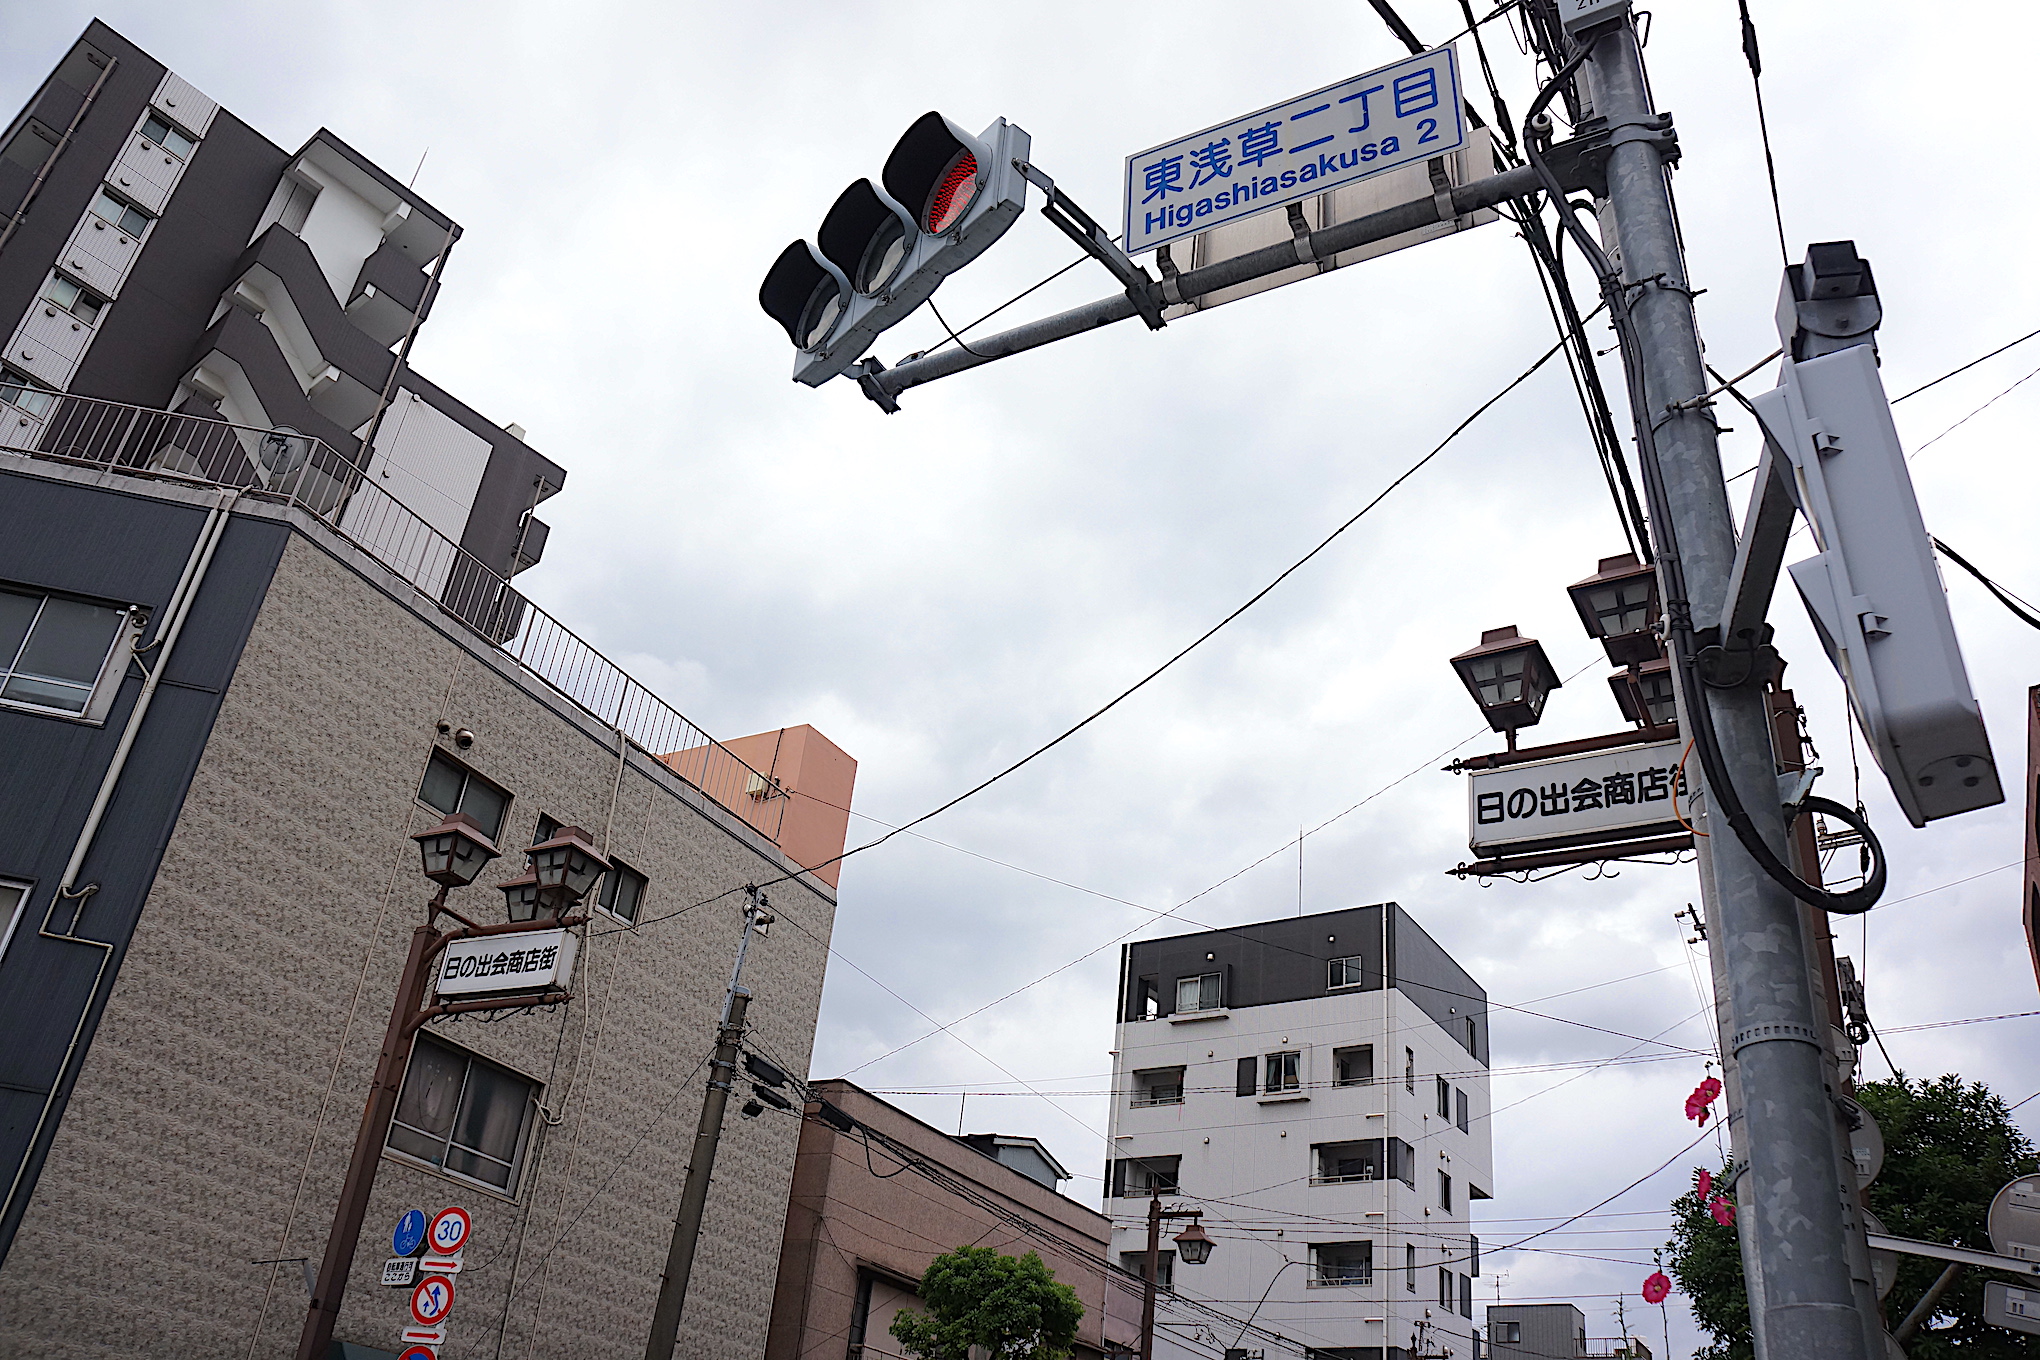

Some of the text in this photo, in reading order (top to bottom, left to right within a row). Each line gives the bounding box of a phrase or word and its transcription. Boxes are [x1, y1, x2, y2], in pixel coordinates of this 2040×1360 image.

[1141, 67, 1439, 205] 東浅草二丁目
[1144, 118, 1440, 235] Higashiasakusa 2
[443, 945, 559, 980] 日の出会商店街
[437, 1220, 462, 1241] 30
[384, 1272, 410, 1282] ここから
